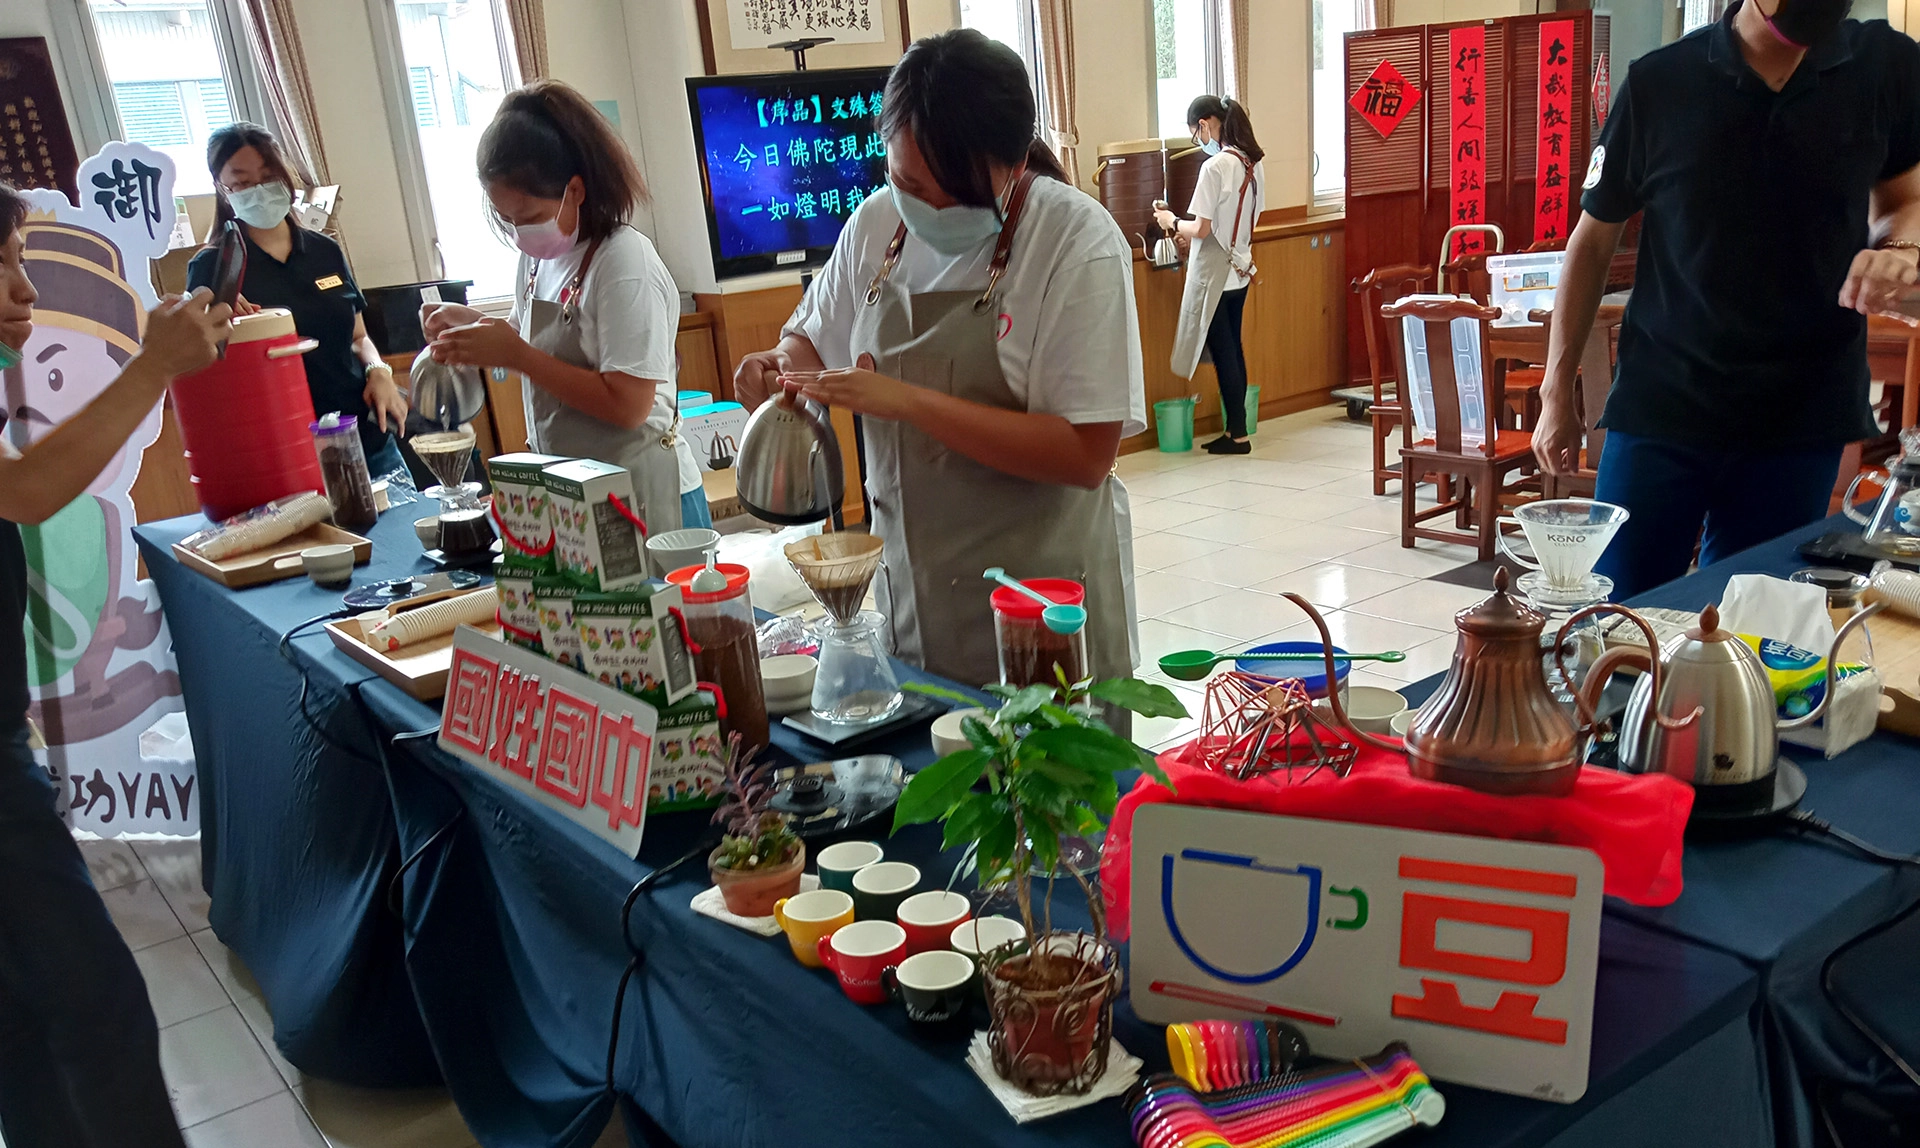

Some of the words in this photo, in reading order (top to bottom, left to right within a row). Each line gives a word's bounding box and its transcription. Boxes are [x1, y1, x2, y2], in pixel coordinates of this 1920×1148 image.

[1363, 77, 1405, 118] 福
[733, 132, 887, 172] 今日佛陀現此
[741, 184, 888, 222] 一如燈明我
[442, 647, 653, 831] 國姓國中
